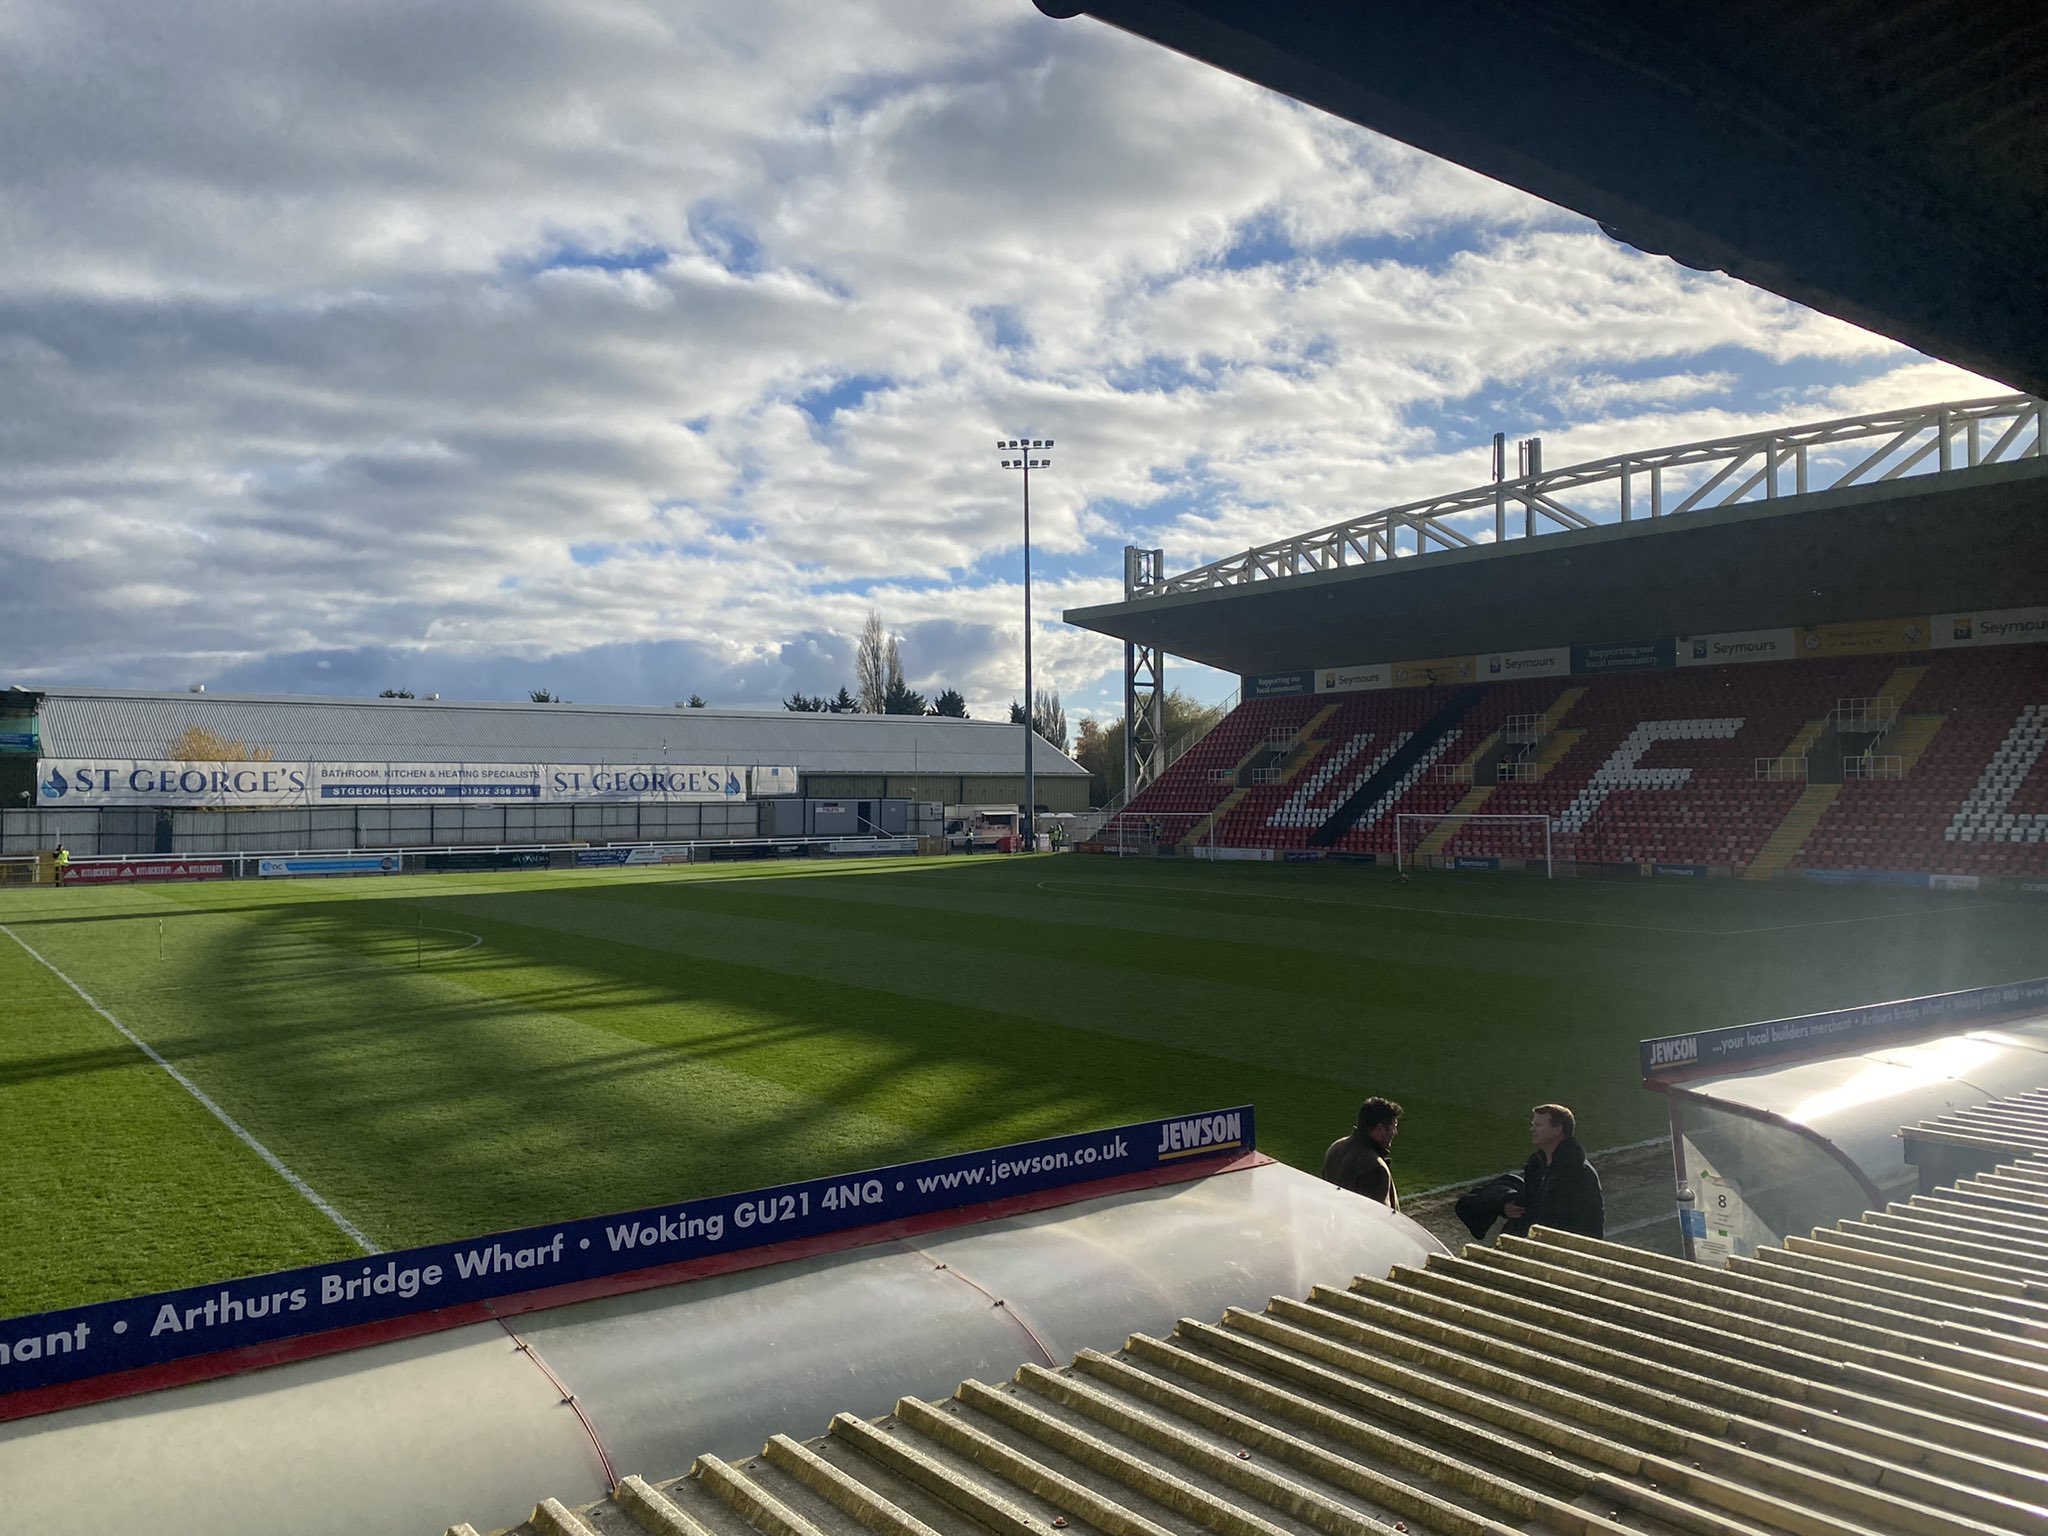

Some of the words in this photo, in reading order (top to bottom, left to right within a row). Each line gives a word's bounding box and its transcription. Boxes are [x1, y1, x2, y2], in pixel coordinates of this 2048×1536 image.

[1981, 619, 2048, 637] Seymou
[1589, 647, 1638, 658] Supporting
[1639, 646, 1656, 654] our
[1713, 641, 1776, 656] Seymours
[1504, 656, 1556, 671] Seymours
[1586, 658, 1607, 669] local
[1607, 655, 1658, 668] community
[1258, 677, 1290, 687] Supporting
[1338, 674, 1380, 686] Seymours
[1256, 686, 1271, 694] local
[1271, 684, 1304, 693] community
[76, 768, 118, 793] ST
[129, 768, 305, 793] GEORGE'S
[321, 769, 382, 780] BATHROOM,
[384, 769, 427, 779] KITCHEN
[428, 770, 437, 779] &
[438, 769, 479, 779] HEATING
[481, 770, 540, 780] SPECIALISTS
[553, 772, 585, 793] ST
[592, 770, 721, 793] GEORGE'S
[332, 786, 446, 796] STGEORGESUK.COM
[461, 786, 491, 796] 01932
[494, 786, 512, 796] 356
[514, 786, 532, 796] 391
[2020, 883, 2048, 892] GOR
[1712, 1036, 1745, 1055] ...your
[1747, 1031, 1770, 1047] local
[1771, 1022, 1809, 1043] builders
[1810, 1017, 1853, 1036] merchant
[1862, 1009, 1893, 1027] Arthurs
[1894, 1004, 1920, 1022] Bridge
[1650, 1037, 1698, 1065] JEWSON
[1158, 1112, 1242, 1153] JEWSON
[1718, 1194, 1727, 1209] 8
[150, 1288, 307, 1337] Arthurs
[321, 1261, 443, 1306] Bridge
[454, 1232, 564, 1280] Wharf
[606, 1212, 725, 1252] Woking
[734, 1191, 810, 1230] GU21
[821, 1178, 884, 1212] 4NQ
[917, 1134, 1129, 1195] www.jewson.co.uk
